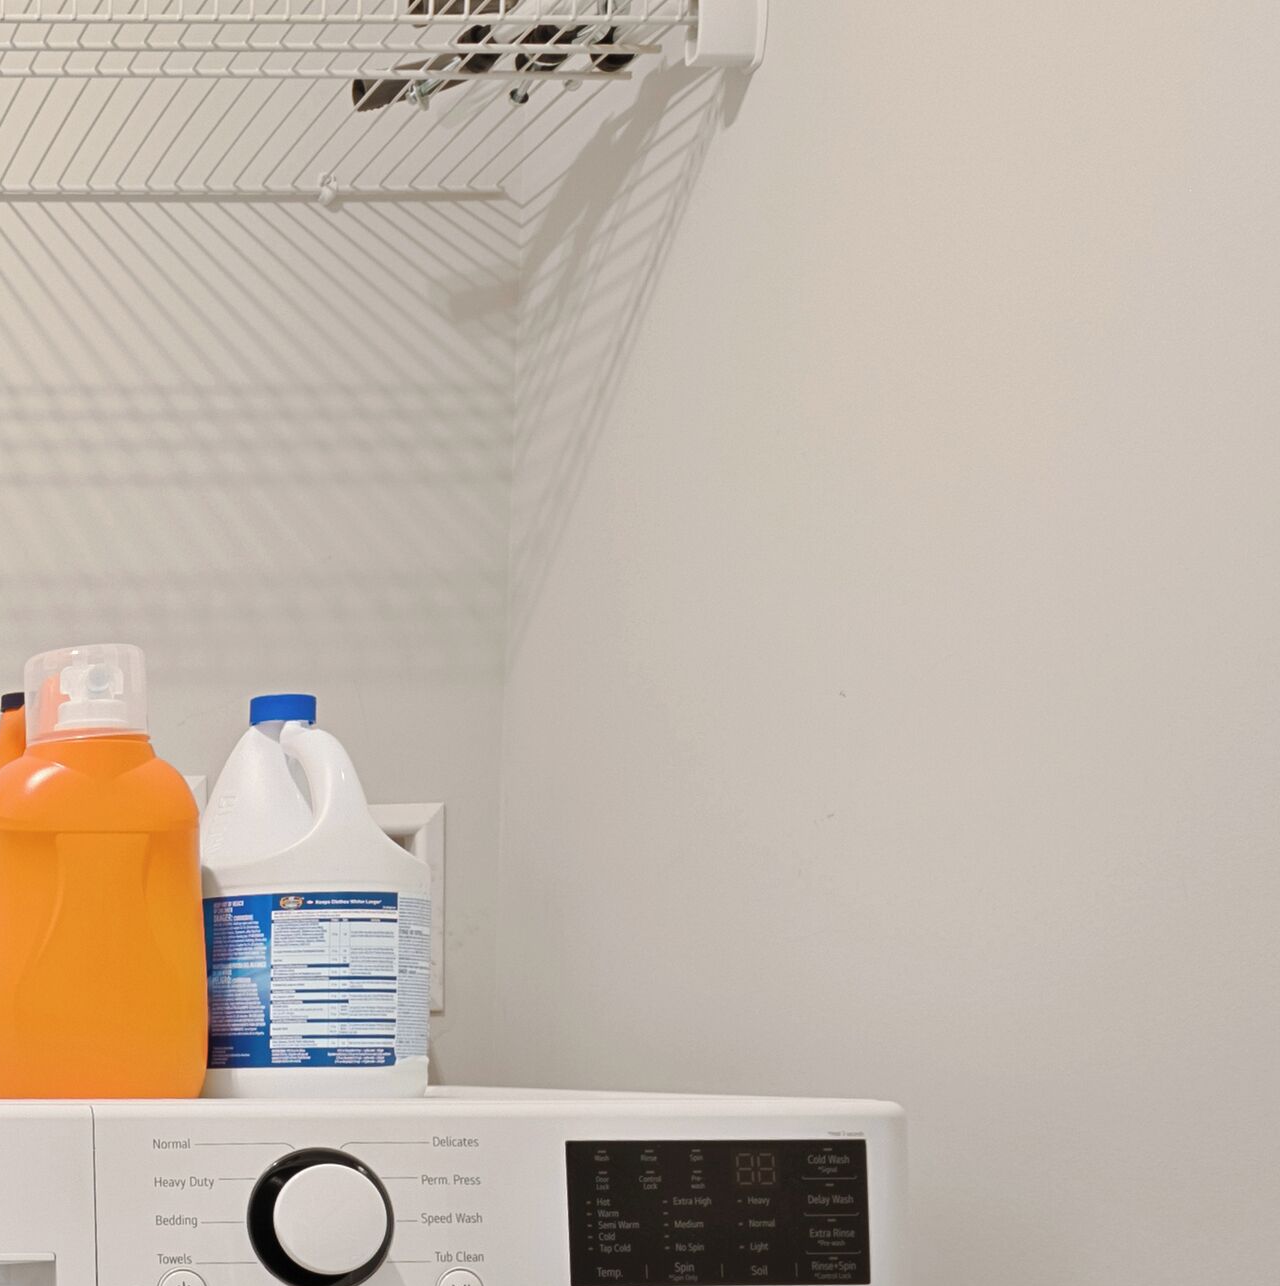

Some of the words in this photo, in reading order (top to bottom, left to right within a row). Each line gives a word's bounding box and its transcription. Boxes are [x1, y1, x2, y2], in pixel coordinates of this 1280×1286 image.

[153, 1138, 191, 1149] Normal
[432, 1136, 480, 1147] Delicates
[807, 1154, 826, 1164] Cold
[827, 1154, 850, 1164] Wash
[154, 1176, 186, 1190] Heavy
[189, 1176, 215, 1190] Duty
[421, 1174, 450, 1186] Perm.
[453, 1174, 482, 1186] Press
[596, 1198, 611, 1207] Hot
[672, 1197, 693, 1206] Extra
[694, 1196, 712, 1207] High
[747, 1196, 771, 1207] Heavy
[807, 1195, 830, 1206] Delay
[832, 1195, 855, 1204] Wash
[421, 1212, 453, 1226] Speed
[455, 1212, 483, 1224] Wash
[597, 1210, 619, 1218] Warm
[156, 1215, 198, 1229] Bedding
[598, 1221, 617, 1229] Semi
[618, 1221, 640, 1229] Warm
[674, 1221, 704, 1229] Medium
[749, 1219, 776, 1228] Normal
[598, 1232, 616, 1241] Cold
[809, 1228, 831, 1238] Extra
[833, 1228, 855, 1238] Rinse
[600, 1244, 612, 1254] Tap
[613, 1244, 631, 1253] Cold
[675, 1243, 687, 1252] No
[688, 1243, 705, 1253] Spin
[750, 1242, 769, 1253] Light
[156, 1253, 193, 1265] Towels
[435, 1251, 453, 1263] Tub
[455, 1251, 484, 1263] Clean
[596, 1267, 623, 1279] Temp.
[674, 1262, 695, 1274] Spin
[751, 1265, 768, 1276] Soil
